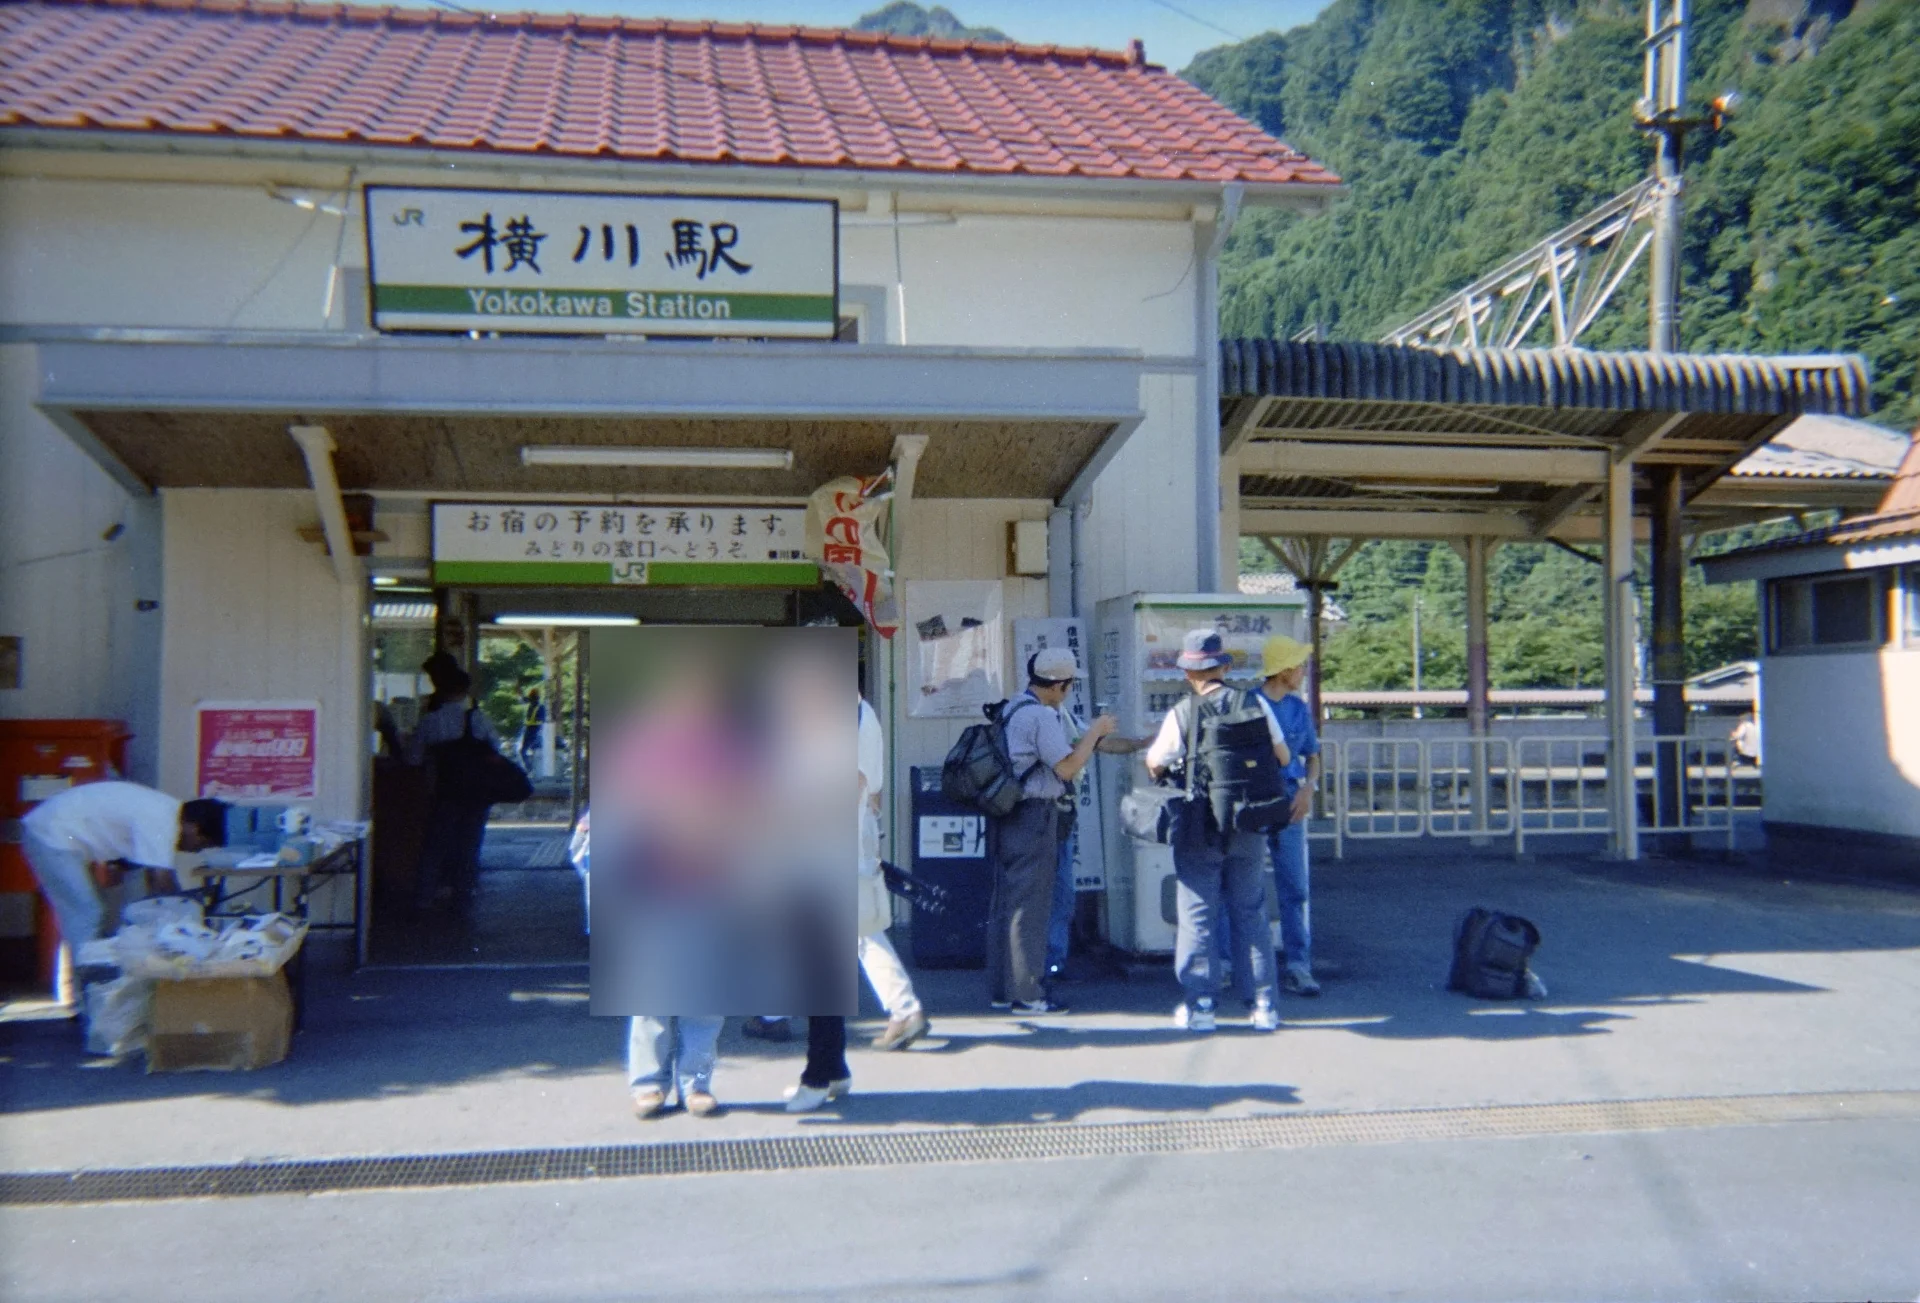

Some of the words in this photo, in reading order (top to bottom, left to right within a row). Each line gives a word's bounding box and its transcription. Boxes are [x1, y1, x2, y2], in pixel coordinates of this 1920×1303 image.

[393, 208, 424, 226] JR
[455, 212, 753, 280] 横川駅
[468, 289, 612, 317] Yokokawa
[626, 291, 731, 319] Station
[467, 509, 787, 537] お宿の予約を承ります。
[614, 561, 647, 580] JR
